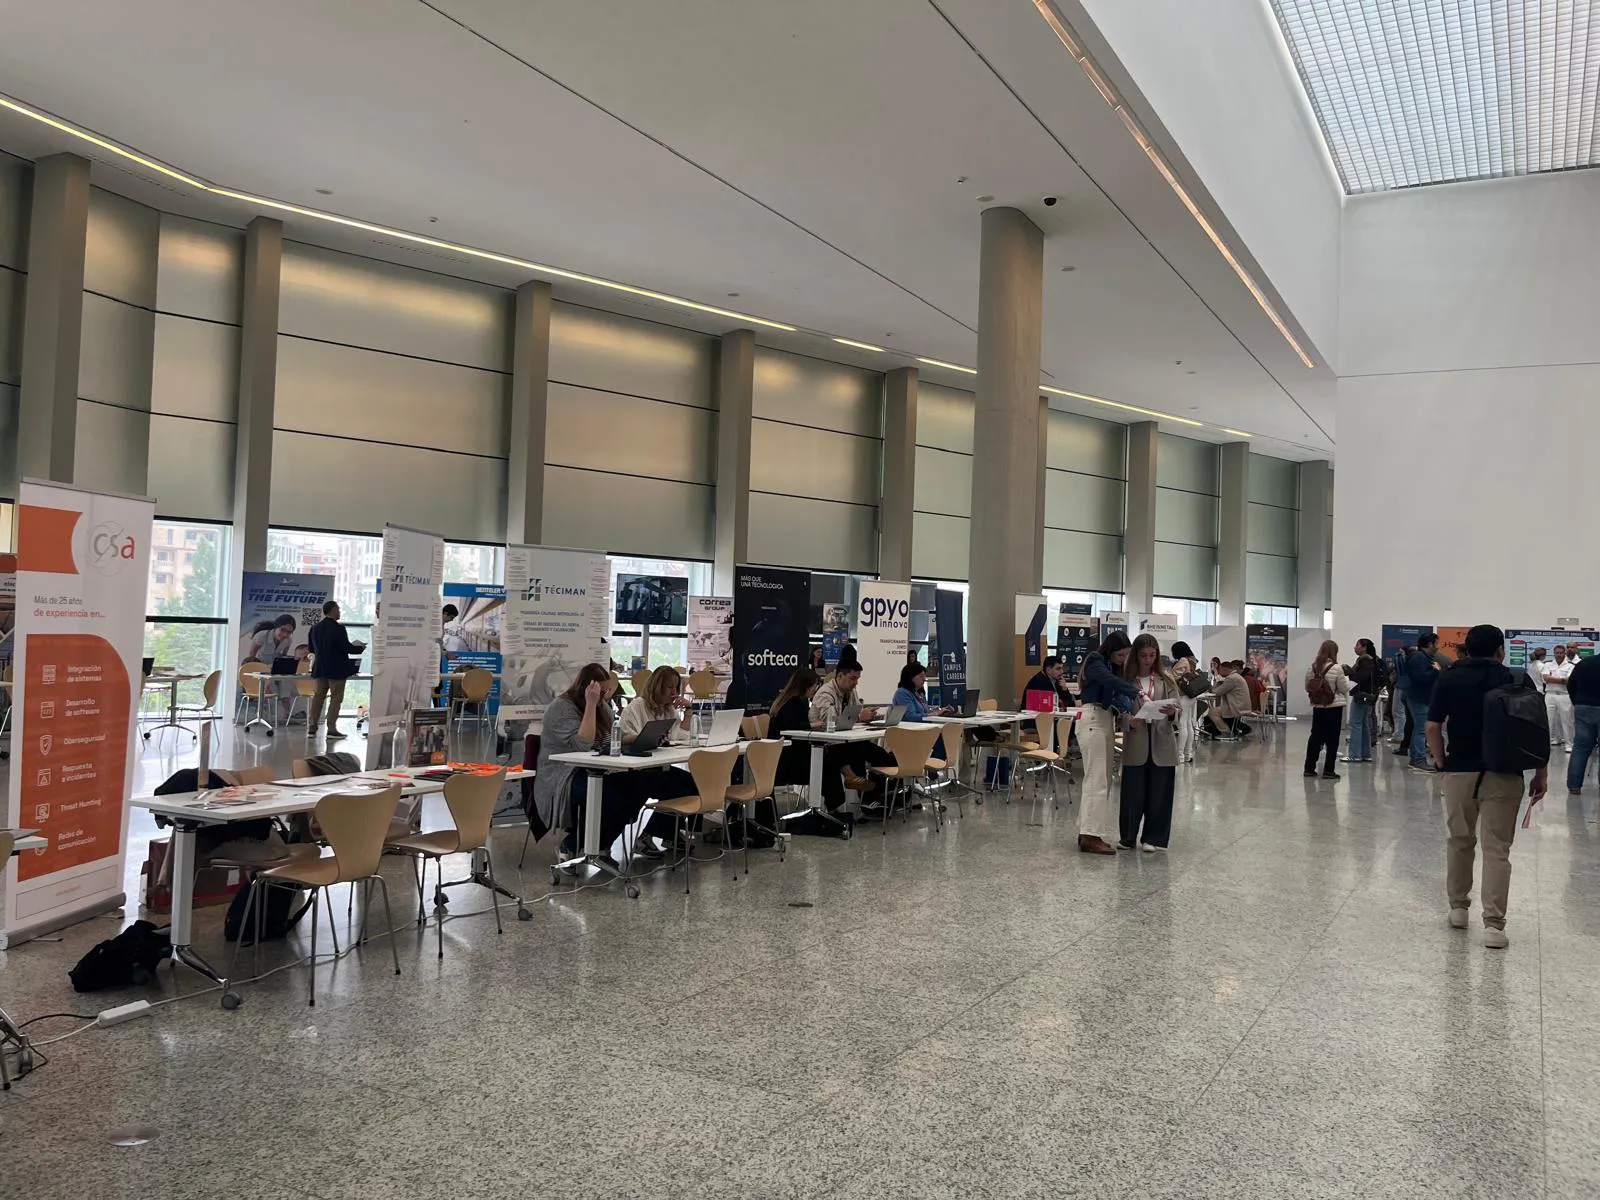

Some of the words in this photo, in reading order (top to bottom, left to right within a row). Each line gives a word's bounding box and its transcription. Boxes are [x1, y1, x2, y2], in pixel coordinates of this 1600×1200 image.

[94, 532, 135, 560] csa
[265, 589, 328, 597] MANUFACTURE
[544, 585, 586, 596] TÉCIMAN
[59, 596, 68, 605] 25
[248, 594, 274, 603] THE
[275, 595, 326, 605] FUTURE
[34, 608, 44, 617] de
[46, 609, 88, 619] experiencia
[860, 596, 909, 627] gpyo
[880, 619, 908, 629] innova
[747, 649, 798, 666] softeca
[67, 665, 102, 674] Integración
[943, 663, 962, 671] CAMPUS
[946, 672, 966, 680] CARRERA
[73, 708, 100, 716] software
[63, 734, 106, 745] Ciberseguridad
